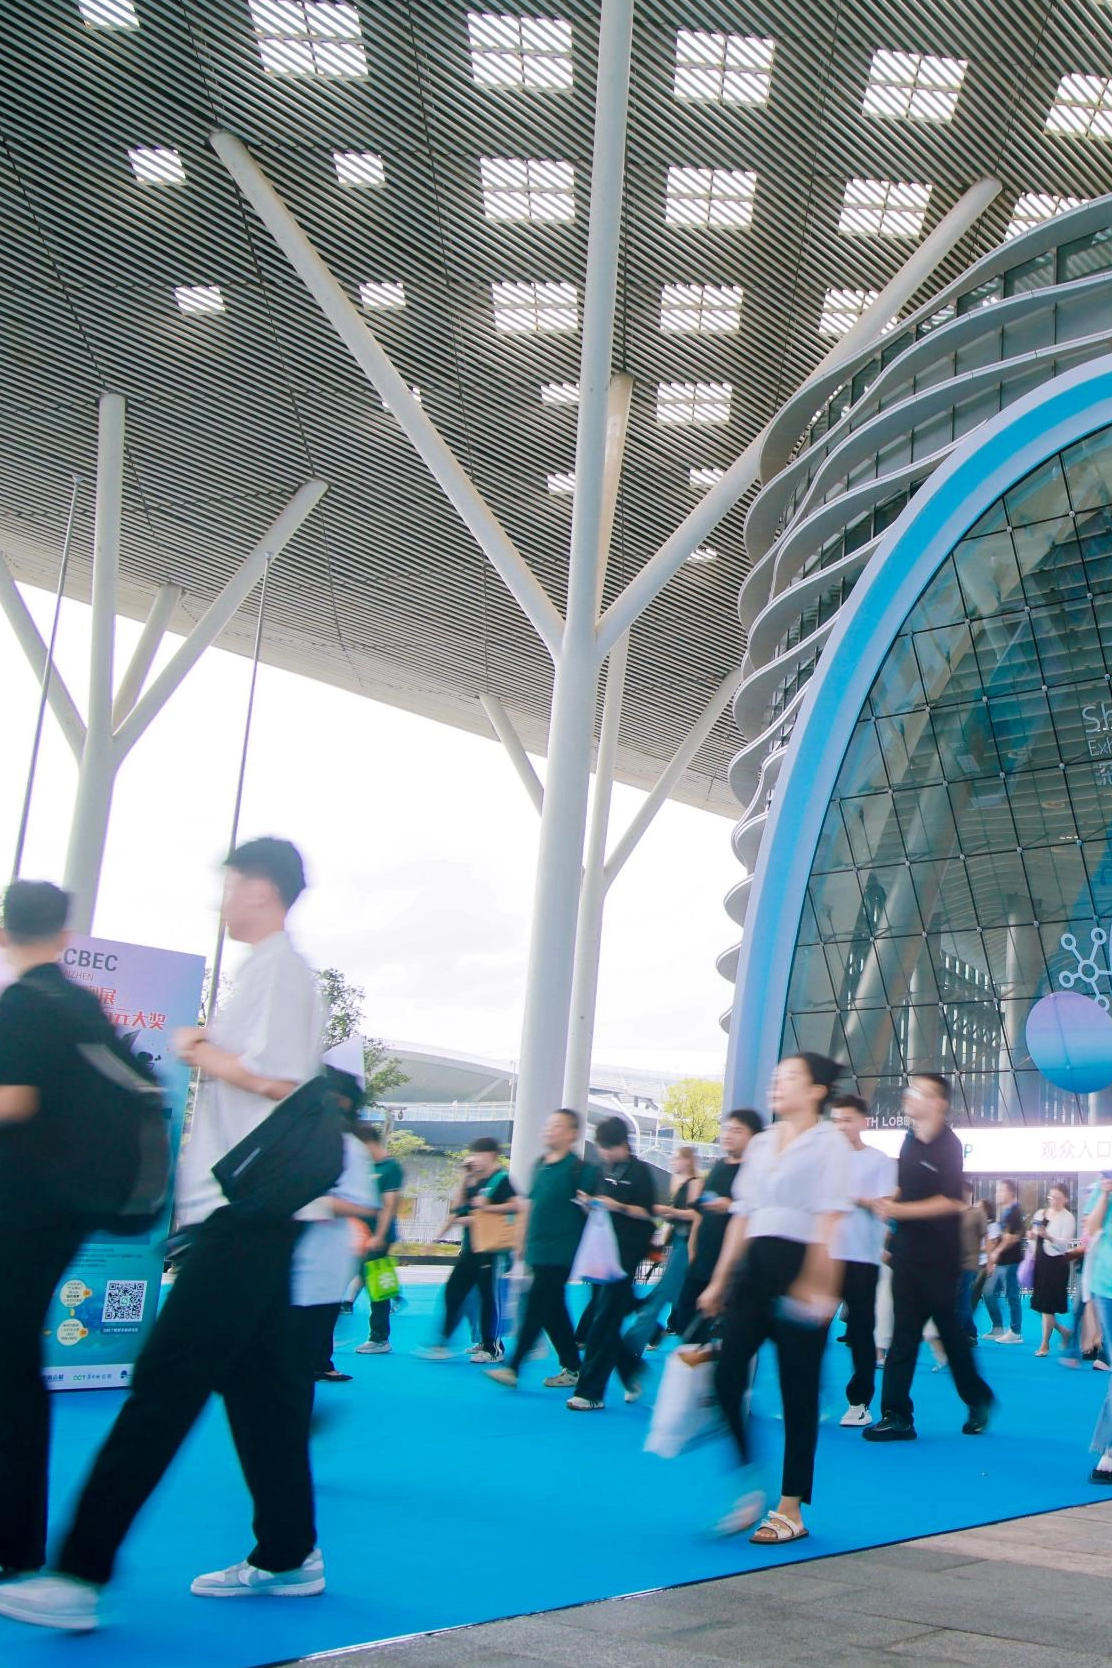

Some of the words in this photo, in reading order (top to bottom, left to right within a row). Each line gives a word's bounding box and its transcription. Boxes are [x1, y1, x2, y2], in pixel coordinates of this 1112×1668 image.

[61, 948, 118, 971] CBEC
[1041, 1140, 1111, 1158] 观众入口
